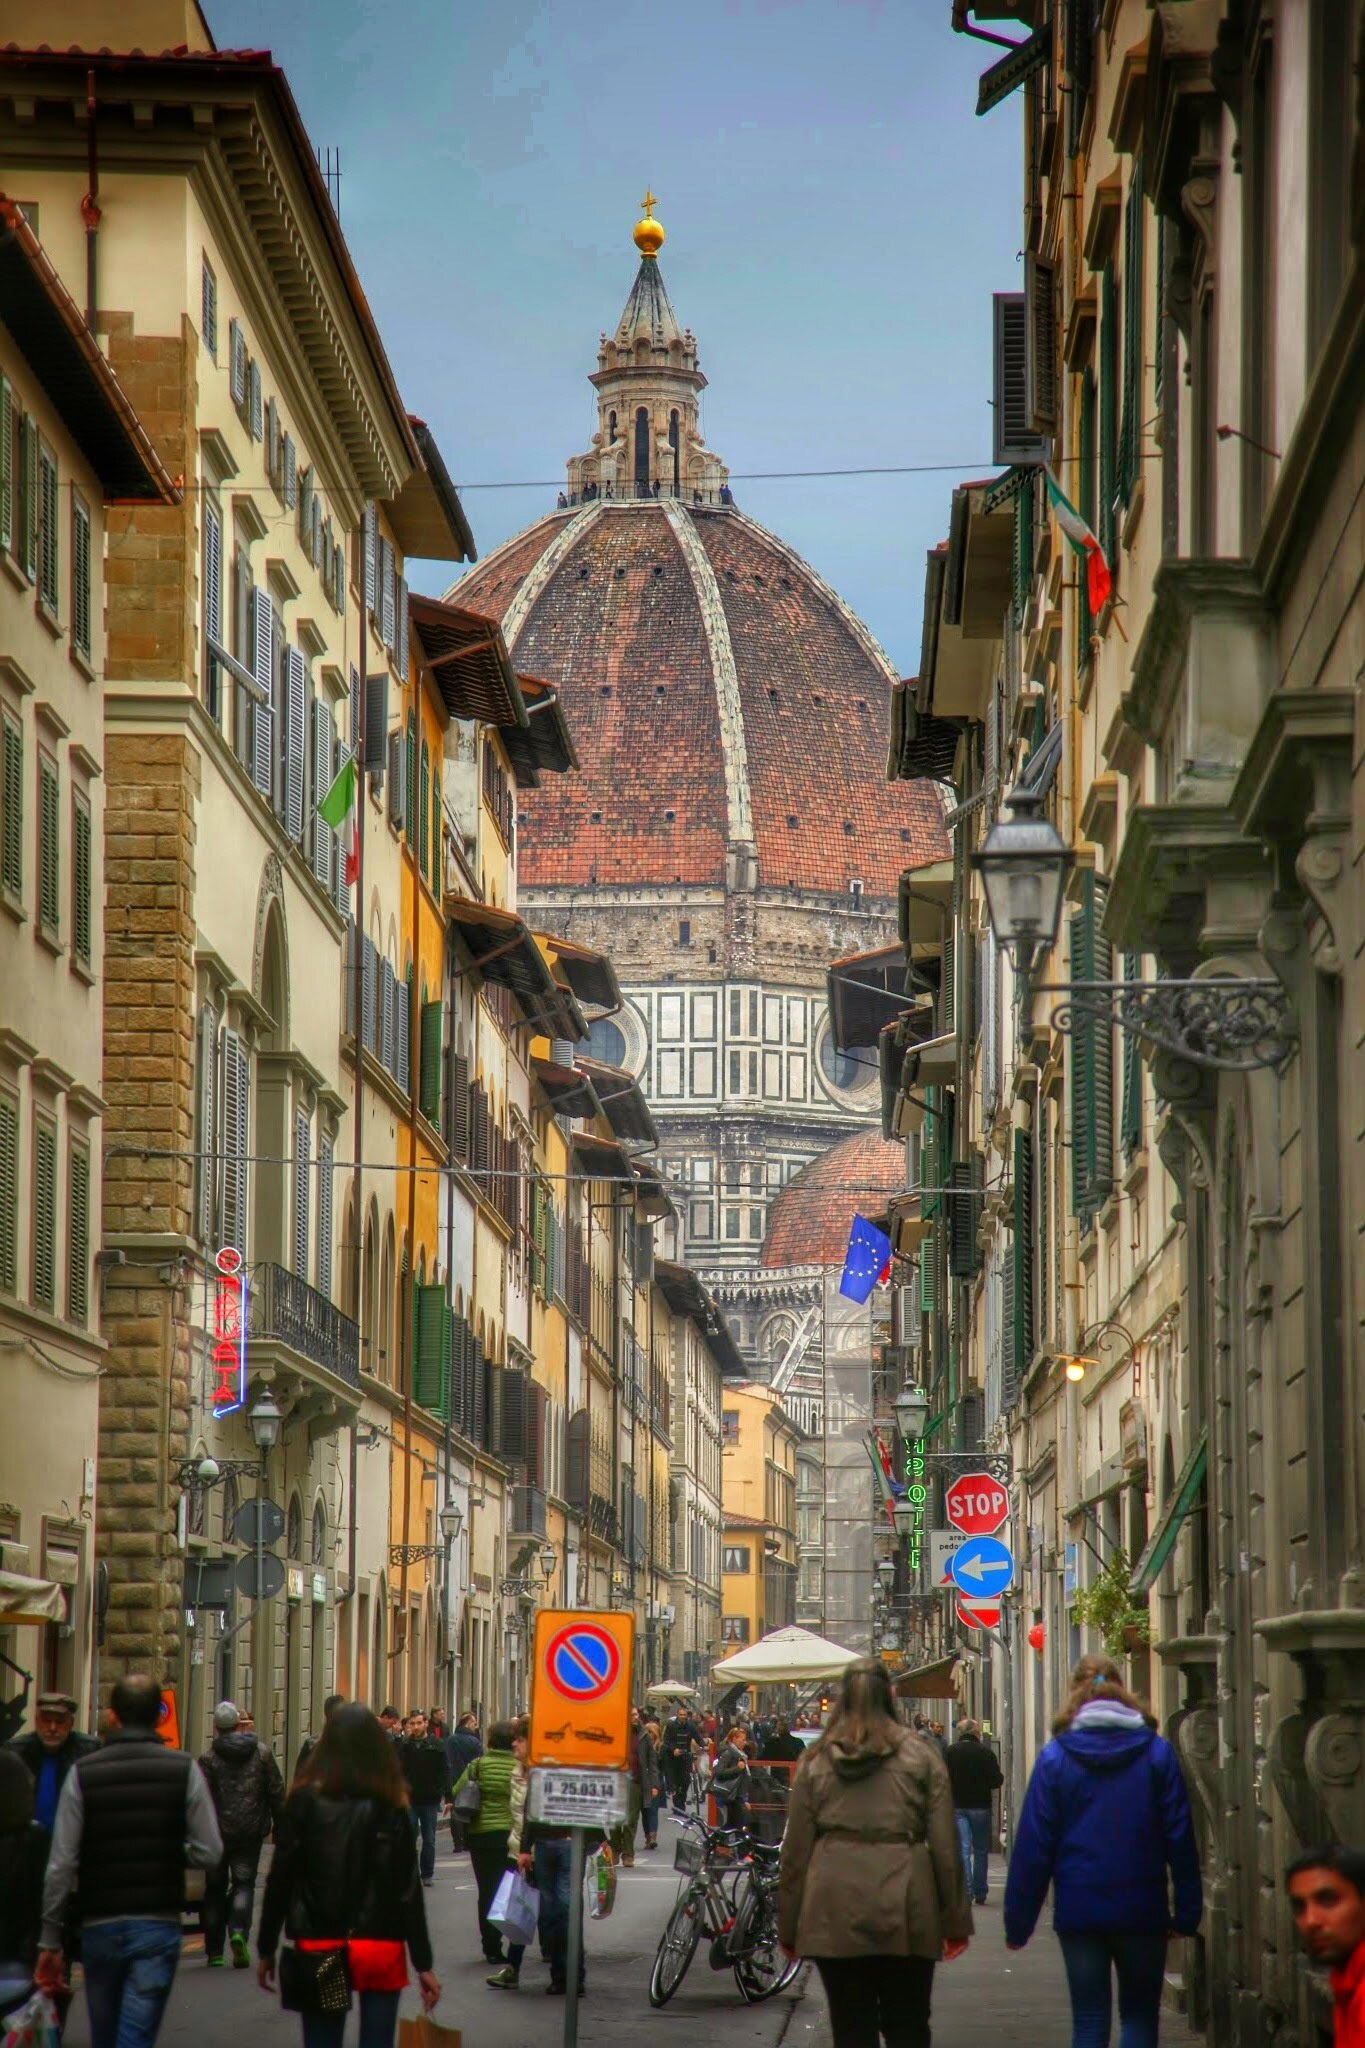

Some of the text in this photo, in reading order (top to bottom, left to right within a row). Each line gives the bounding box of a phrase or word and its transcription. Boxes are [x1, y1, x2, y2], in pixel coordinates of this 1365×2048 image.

[950, 1492, 1004, 1518] STOP
[939, 1543, 961, 1551] pedo
[561, 1782, 614, 1797] 25.03.14
